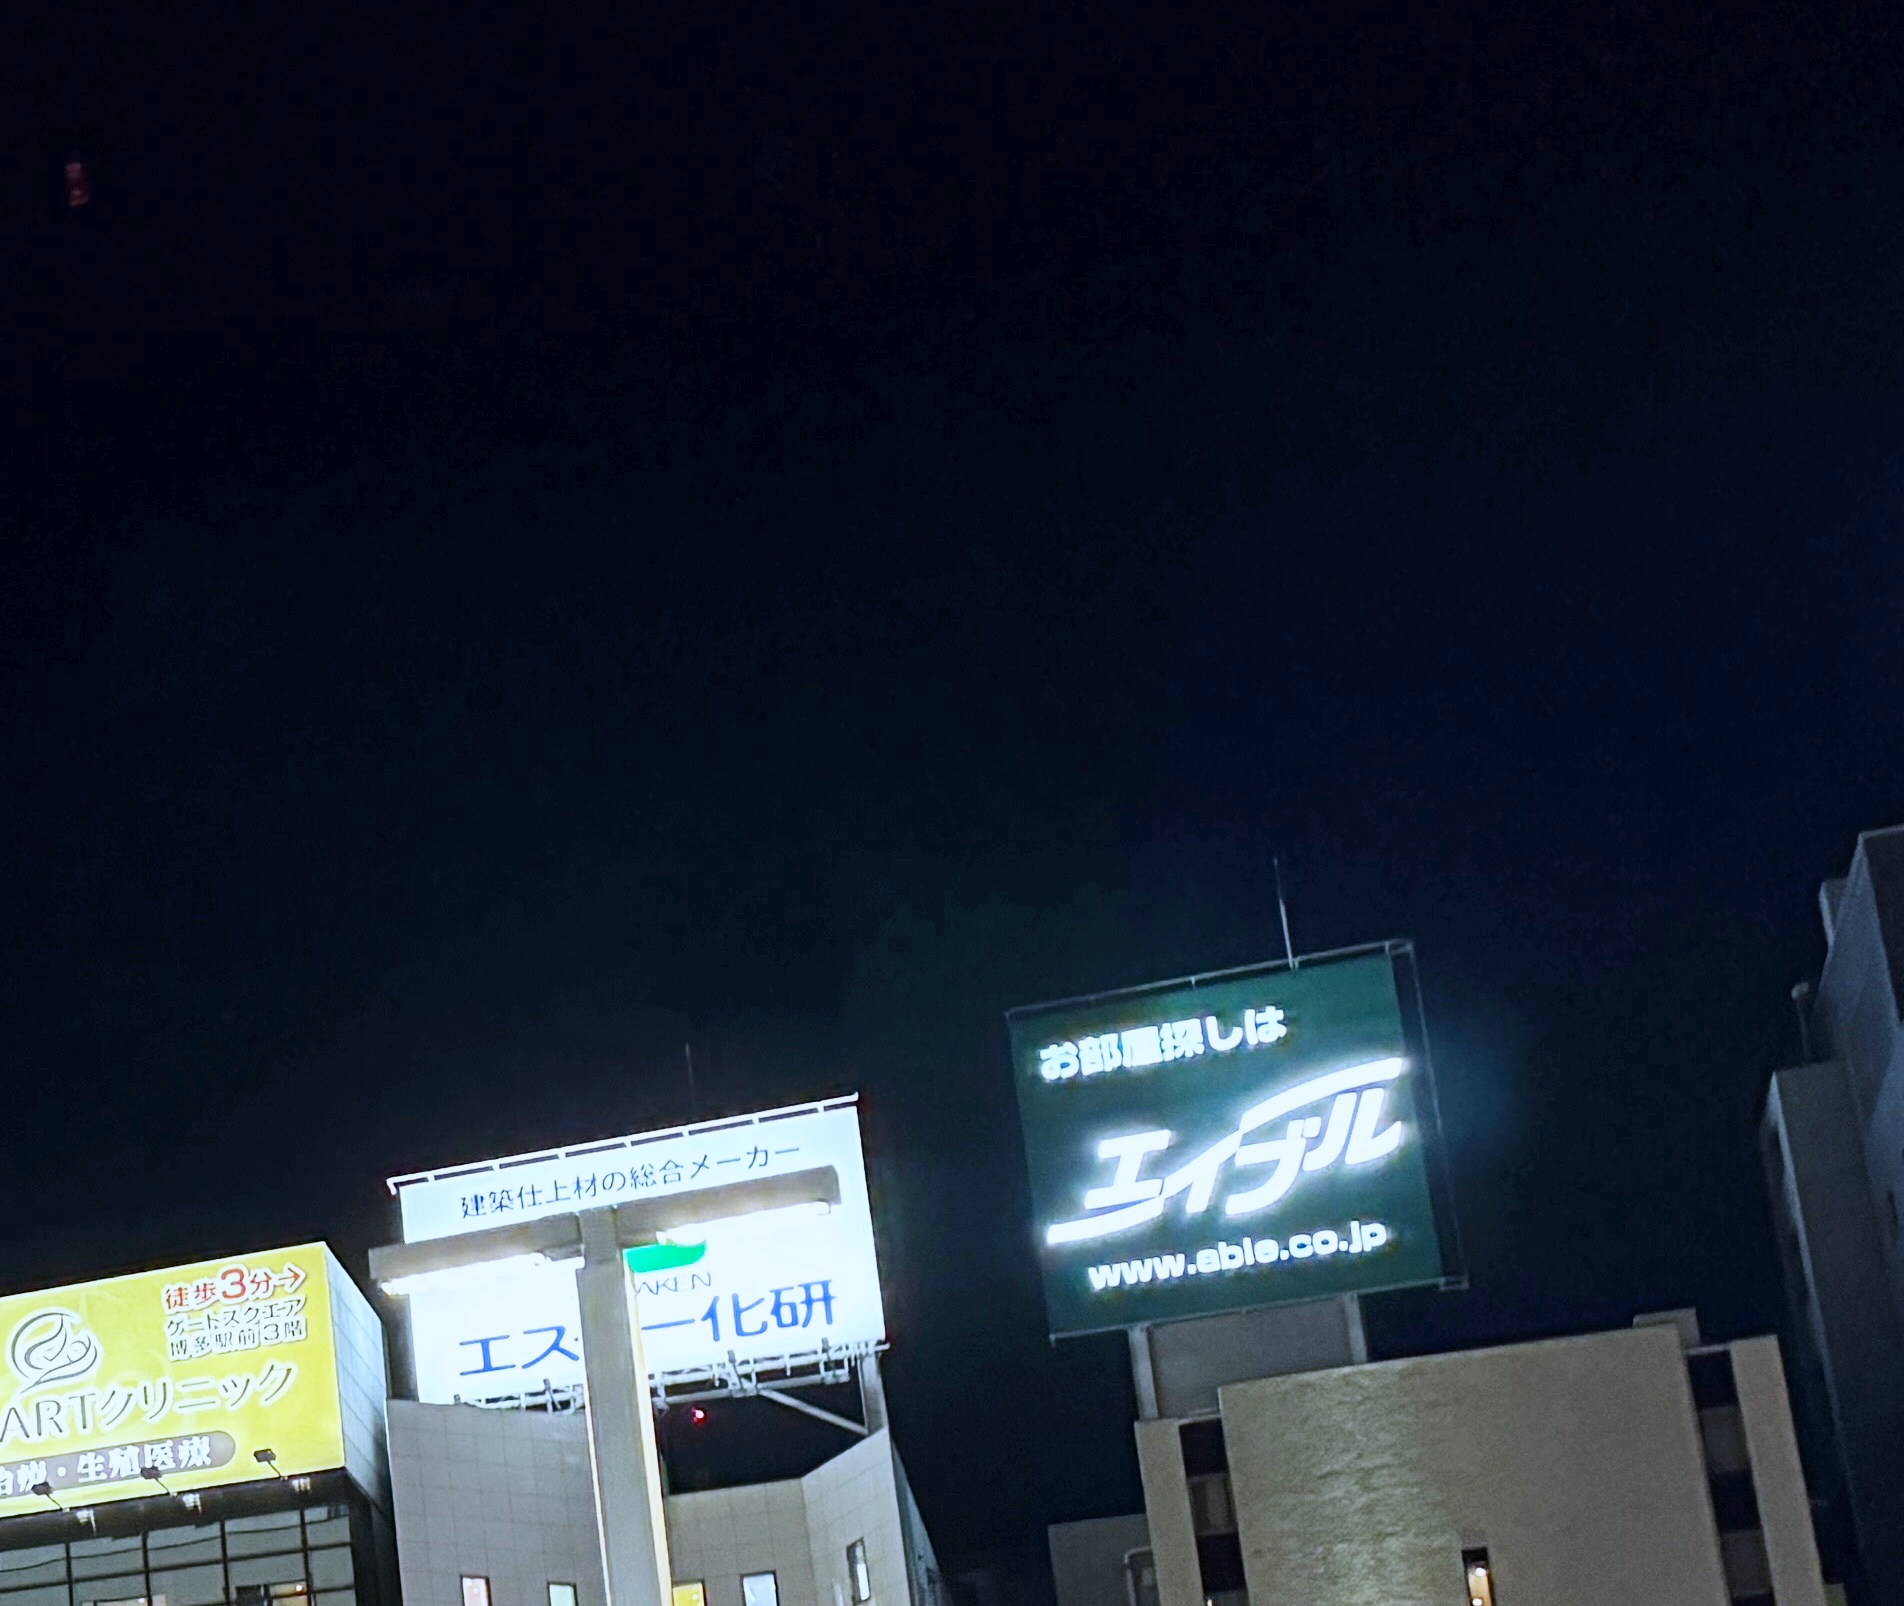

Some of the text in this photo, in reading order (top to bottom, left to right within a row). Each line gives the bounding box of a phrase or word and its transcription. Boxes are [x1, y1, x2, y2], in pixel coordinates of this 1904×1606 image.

[1039, 1006, 1287, 1081] お部屋探しは
[460, 1145, 801, 1219] 建築仕上材の総合メーカー
[1047, 1057, 1405, 1245] エイブル
[165, 1268, 273, 1310] 徒歩3分
[1088, 1220, 1388, 1290] www.able.co.jp
